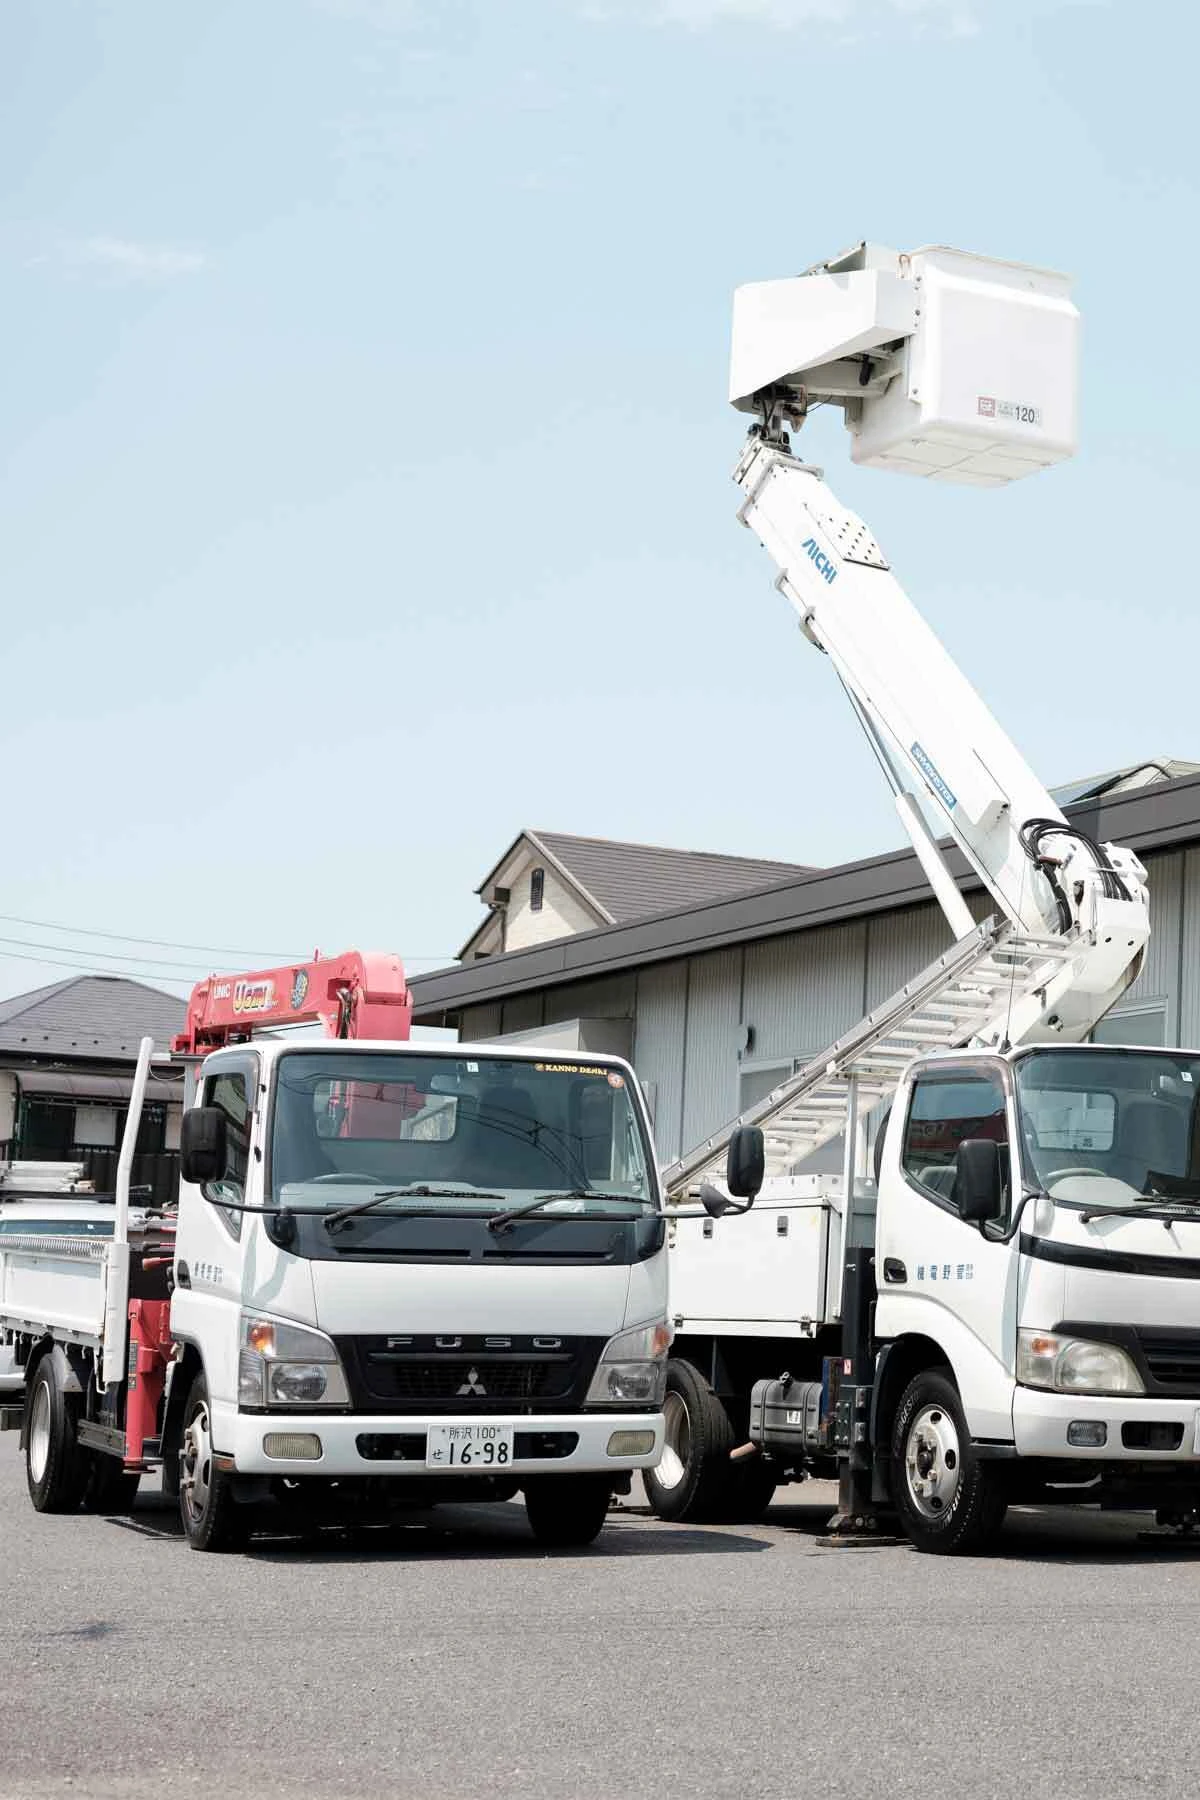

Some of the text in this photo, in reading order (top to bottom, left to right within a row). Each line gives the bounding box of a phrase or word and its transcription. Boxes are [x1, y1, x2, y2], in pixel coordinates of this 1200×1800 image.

[1015, 405, 1035, 423] 120
[801, 538, 837, 584] AICHI
[545, 1064, 578, 1073] KANNO
[387, 1336, 562, 1349] FUSO
[449, 1427, 496, 1439] 所沢 100
[449, 1442, 508, 1465] 16-98
